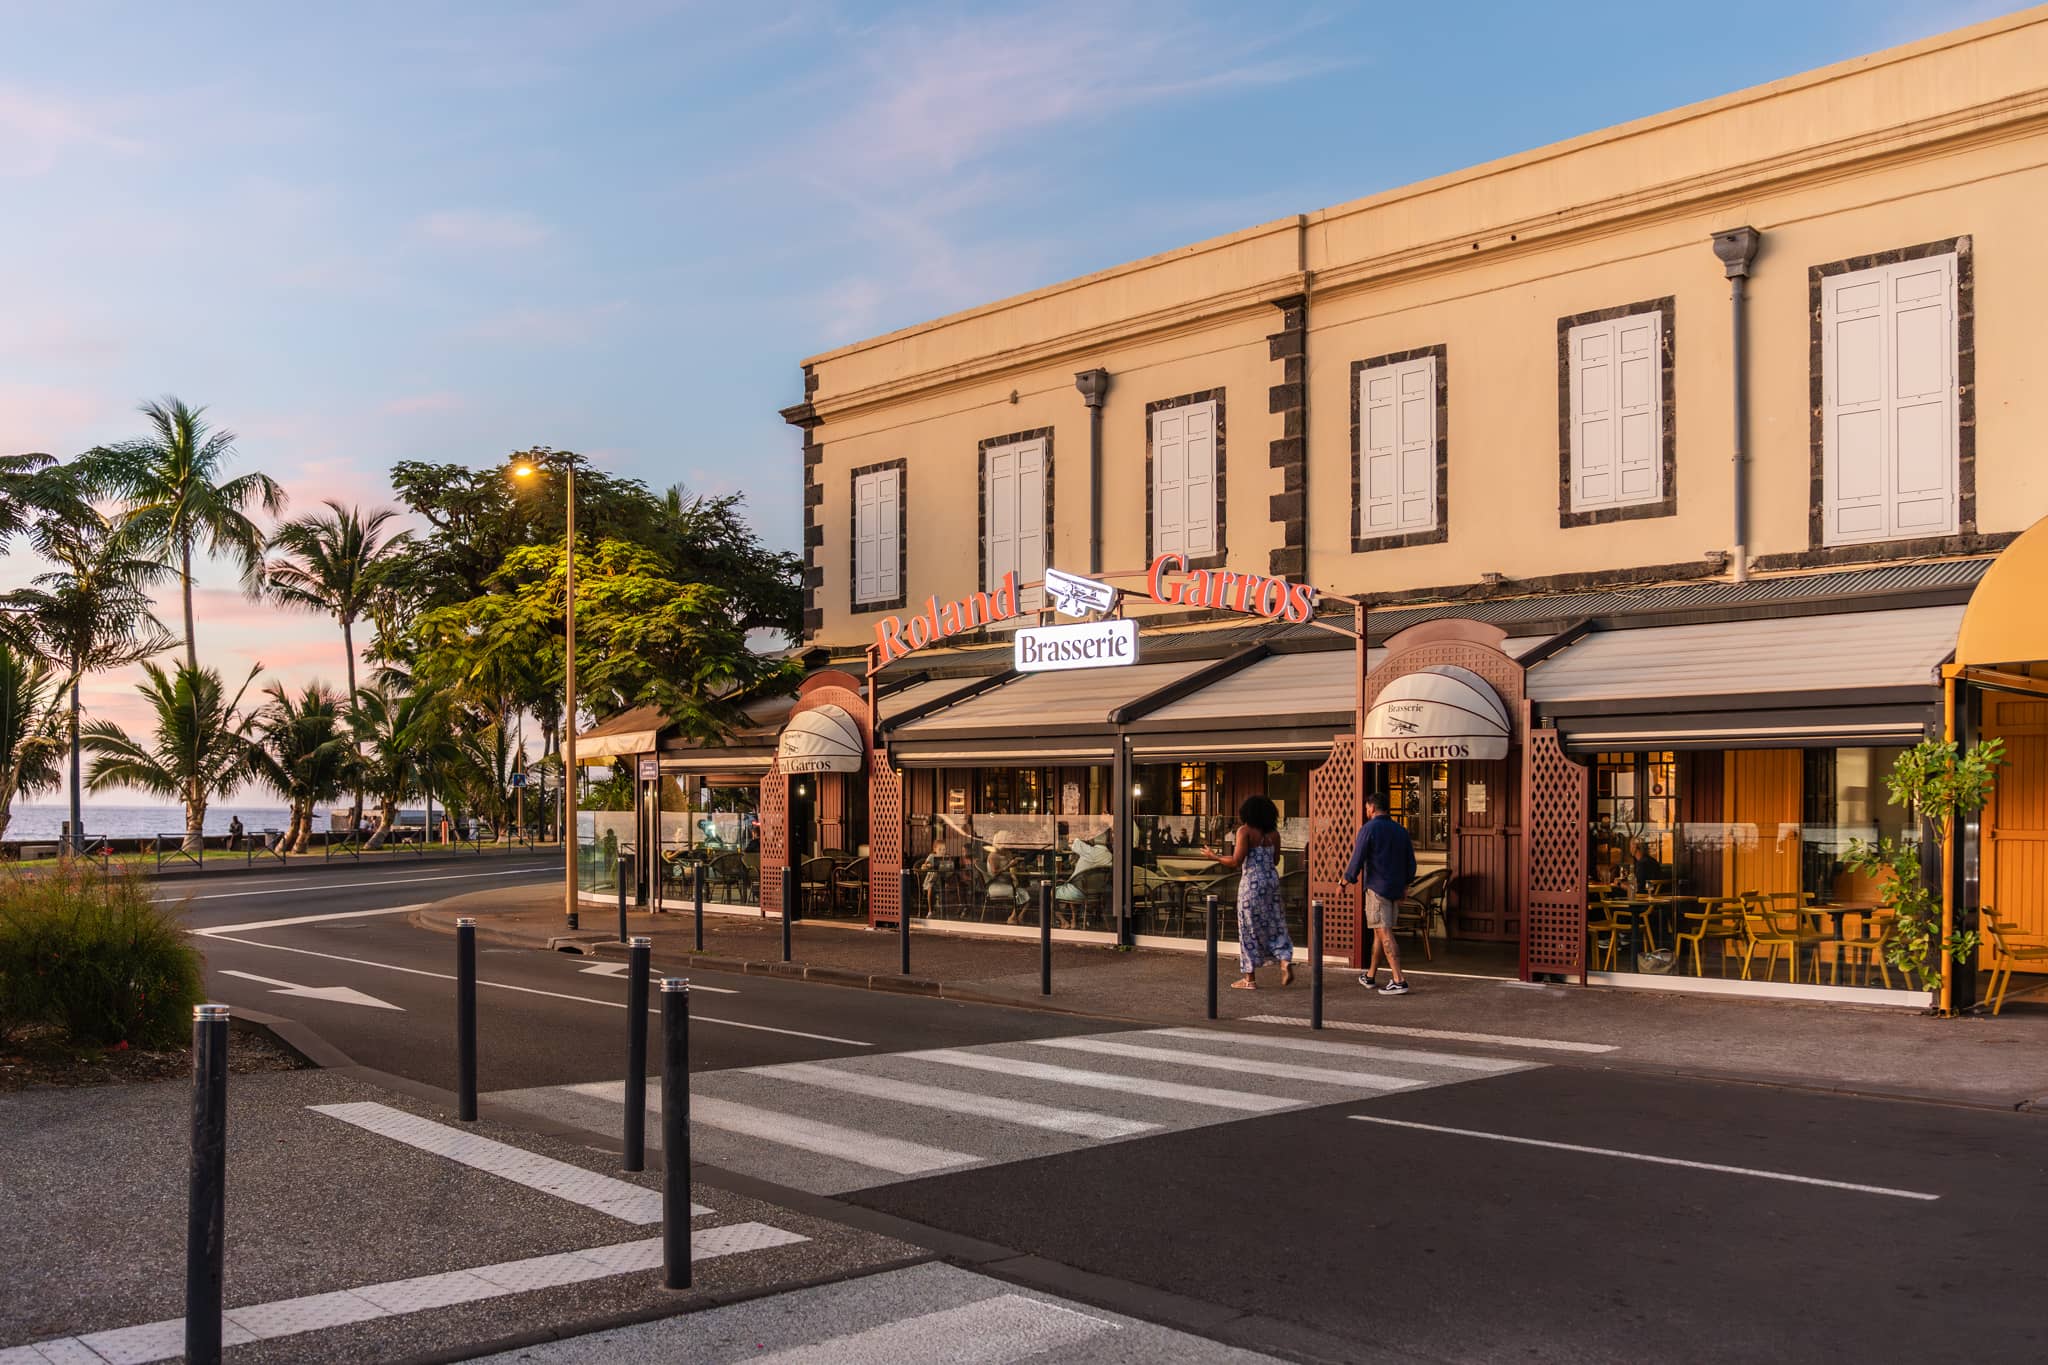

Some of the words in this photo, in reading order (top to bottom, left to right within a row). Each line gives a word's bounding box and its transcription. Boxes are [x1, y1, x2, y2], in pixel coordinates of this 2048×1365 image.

[873, 570, 1020, 664] Roland
[1147, 553, 1315, 623] Garros
[1021, 628, 1128, 664] Brasserie
[1388, 703, 1424, 713] Brasserie
[1403, 741, 1470, 759] Garros
[791, 760, 831, 771] Garros
